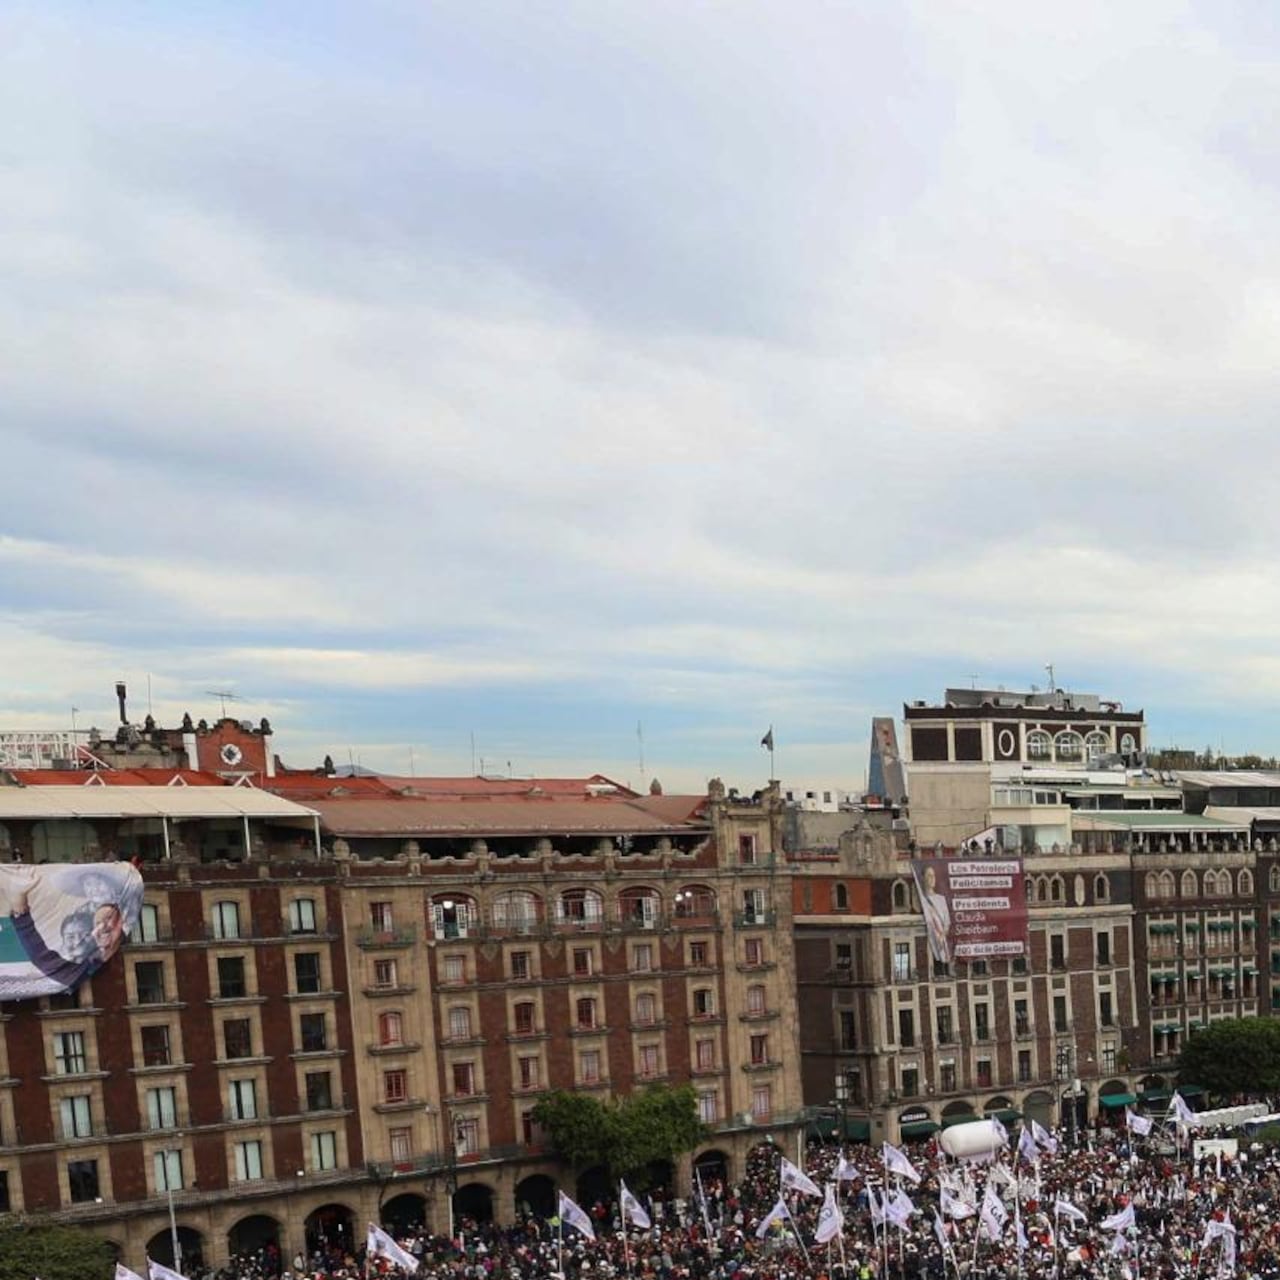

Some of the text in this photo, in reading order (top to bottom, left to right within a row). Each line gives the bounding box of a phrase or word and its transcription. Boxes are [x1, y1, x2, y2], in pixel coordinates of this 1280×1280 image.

[951, 864, 1017, 873] Los Petroleros
[952, 879, 1009, 888] Felicitamos
[954, 900, 1008, 909] Presidenta
[954, 911, 986, 923] Claudia
[955, 923, 999, 935] Sheinbaum
